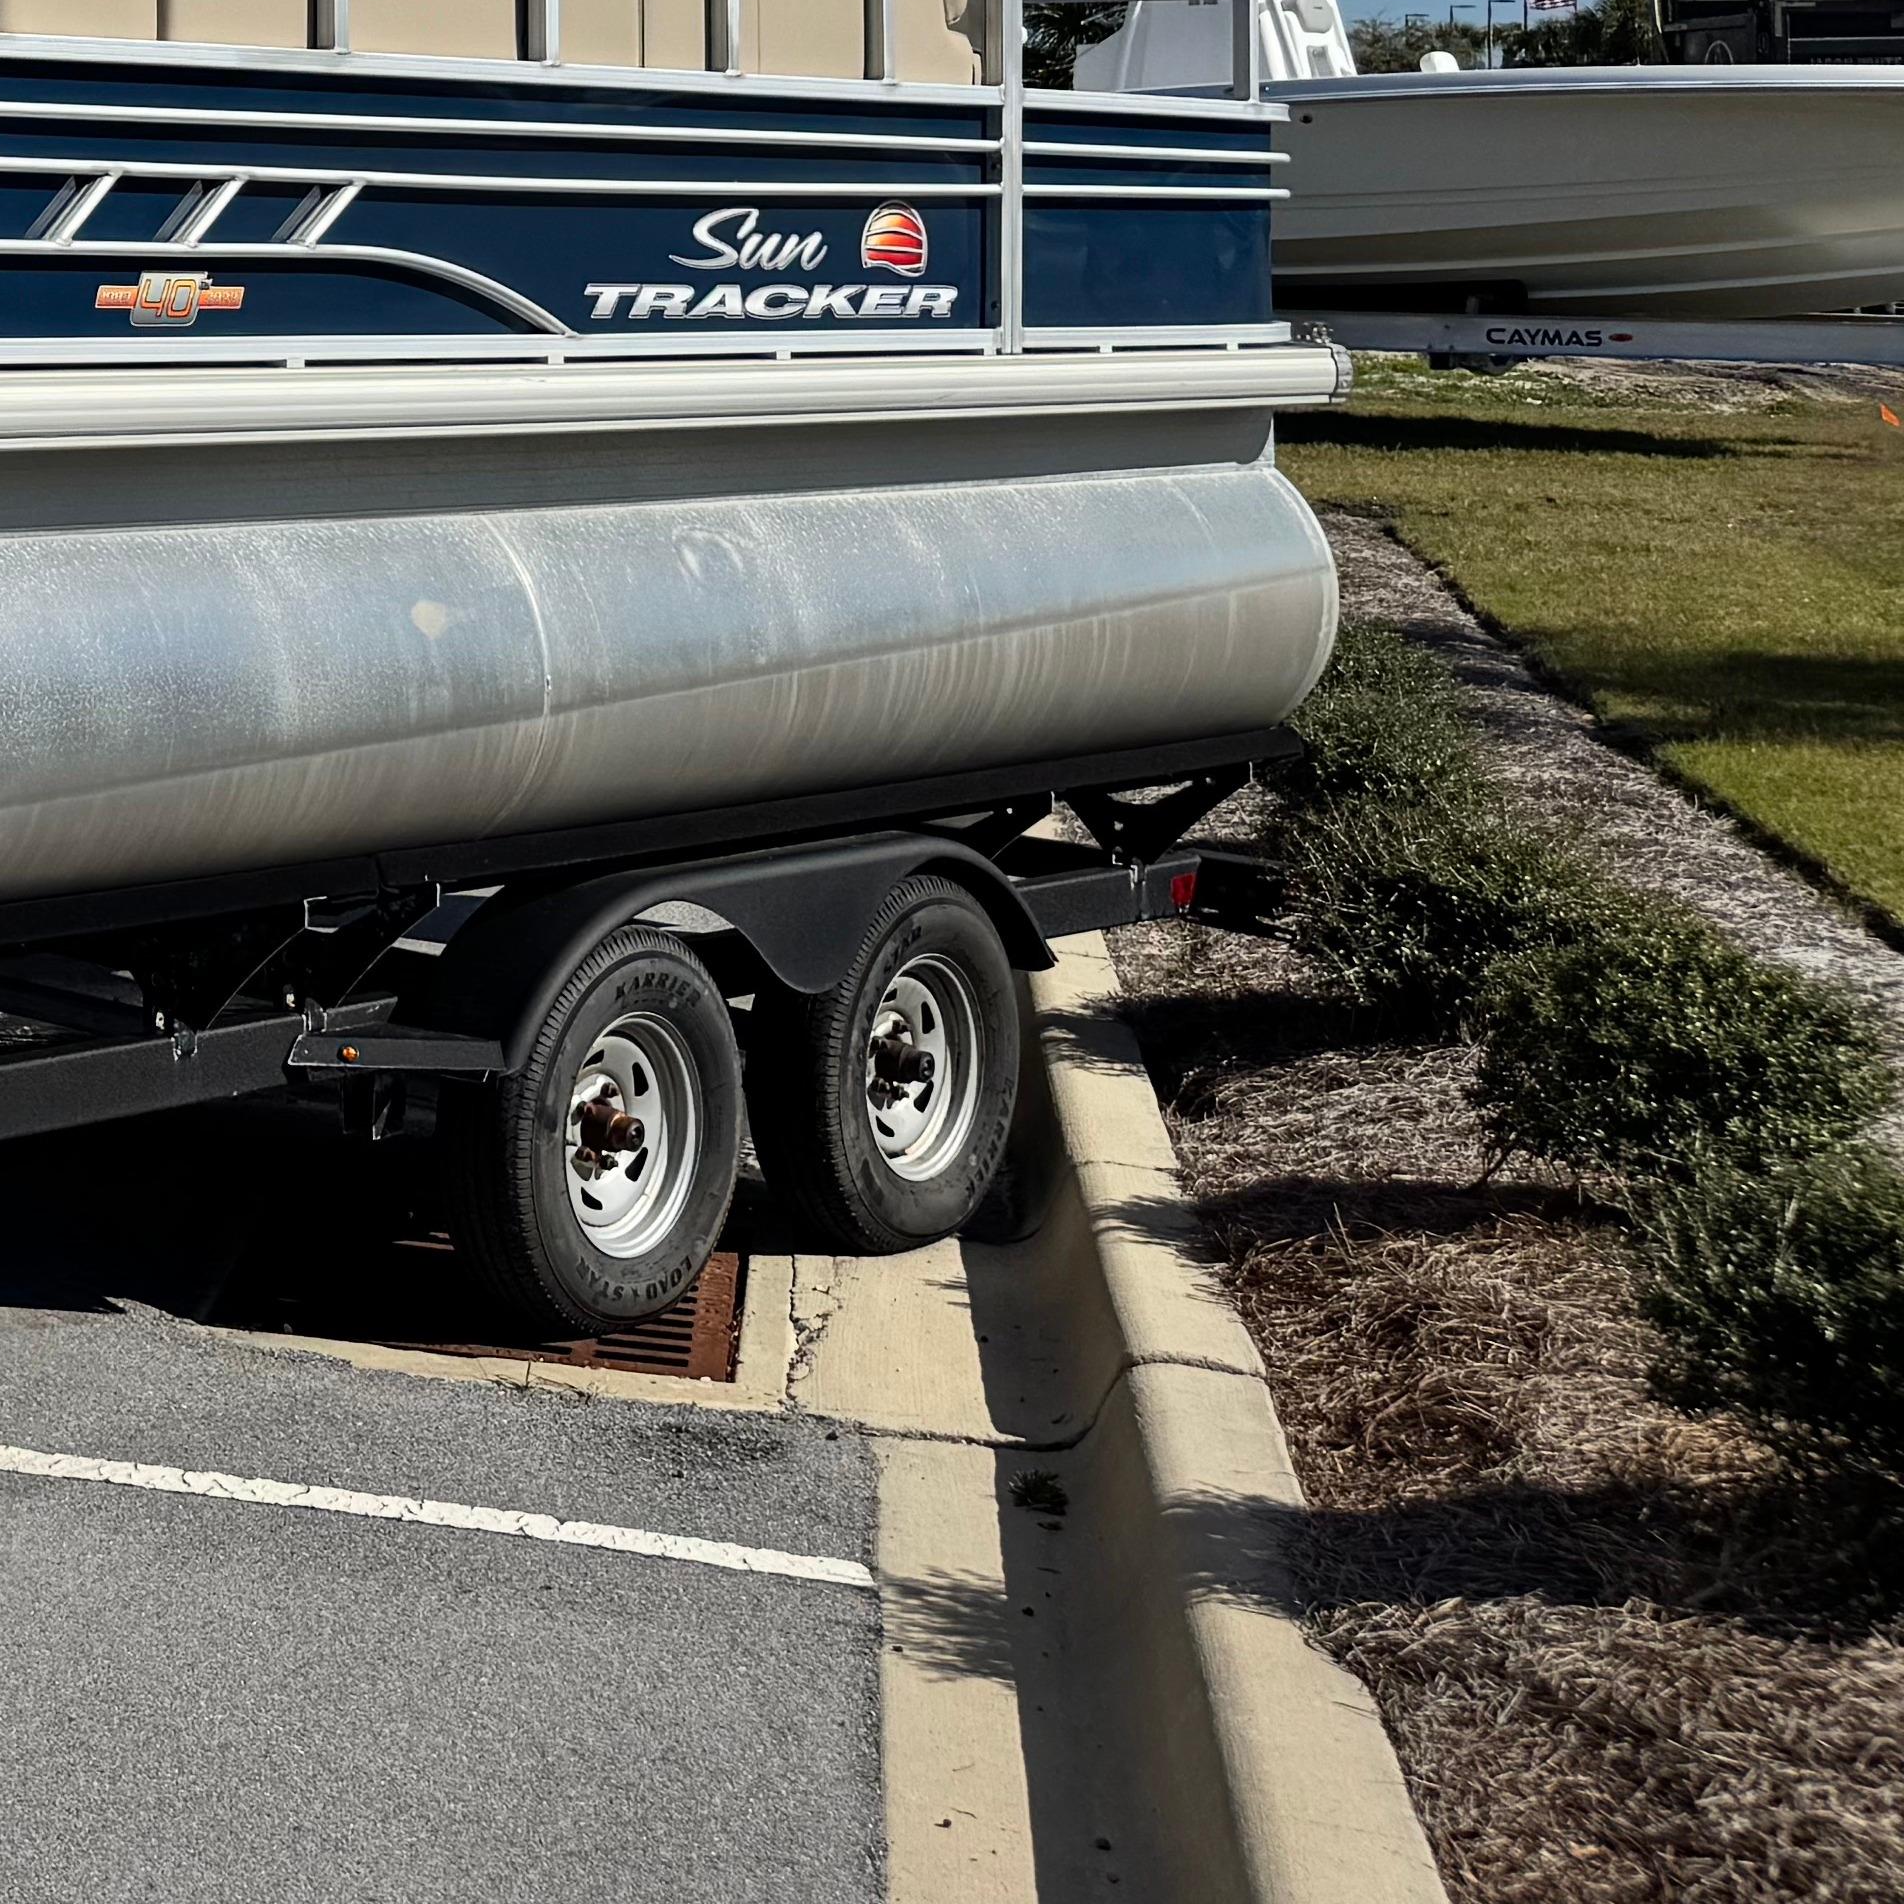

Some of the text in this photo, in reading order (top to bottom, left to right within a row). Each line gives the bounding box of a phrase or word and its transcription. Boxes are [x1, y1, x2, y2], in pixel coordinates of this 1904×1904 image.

[668, 207, 829, 271] Sun
[140, 278, 197, 318] 40
[584, 282, 959, 320] TRACKER
[1486, 327, 1603, 347] CAYMAS
[615, 972, 701, 1008] KARRIER
[646, 1255, 692, 1300] LOAD
